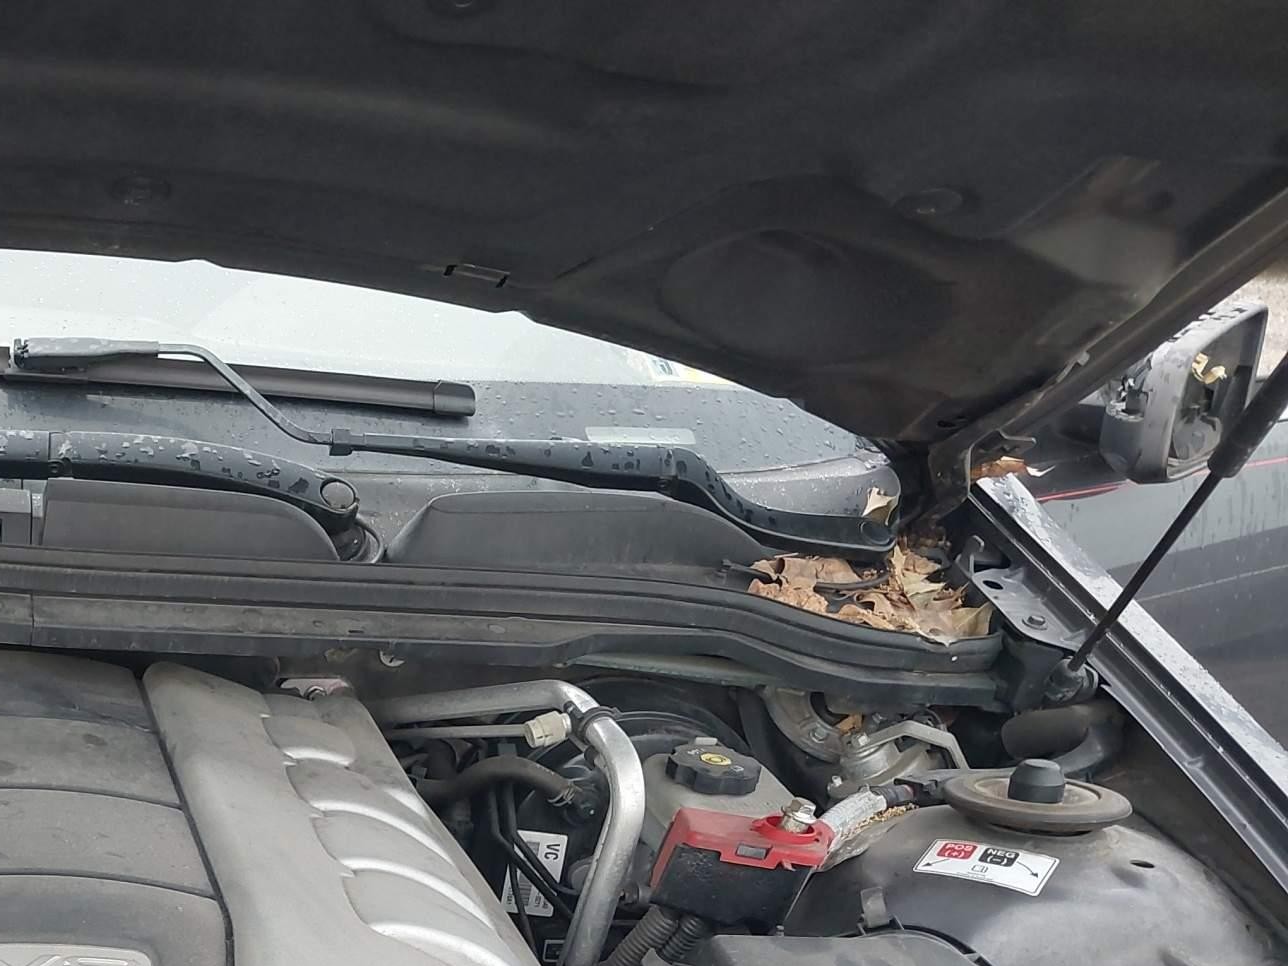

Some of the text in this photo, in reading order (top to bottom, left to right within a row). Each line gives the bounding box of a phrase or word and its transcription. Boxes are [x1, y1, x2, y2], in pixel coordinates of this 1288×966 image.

[544, 843, 560, 861] VC
[945, 842, 973, 853] POS
[987, 848, 1016, 858] NEG
